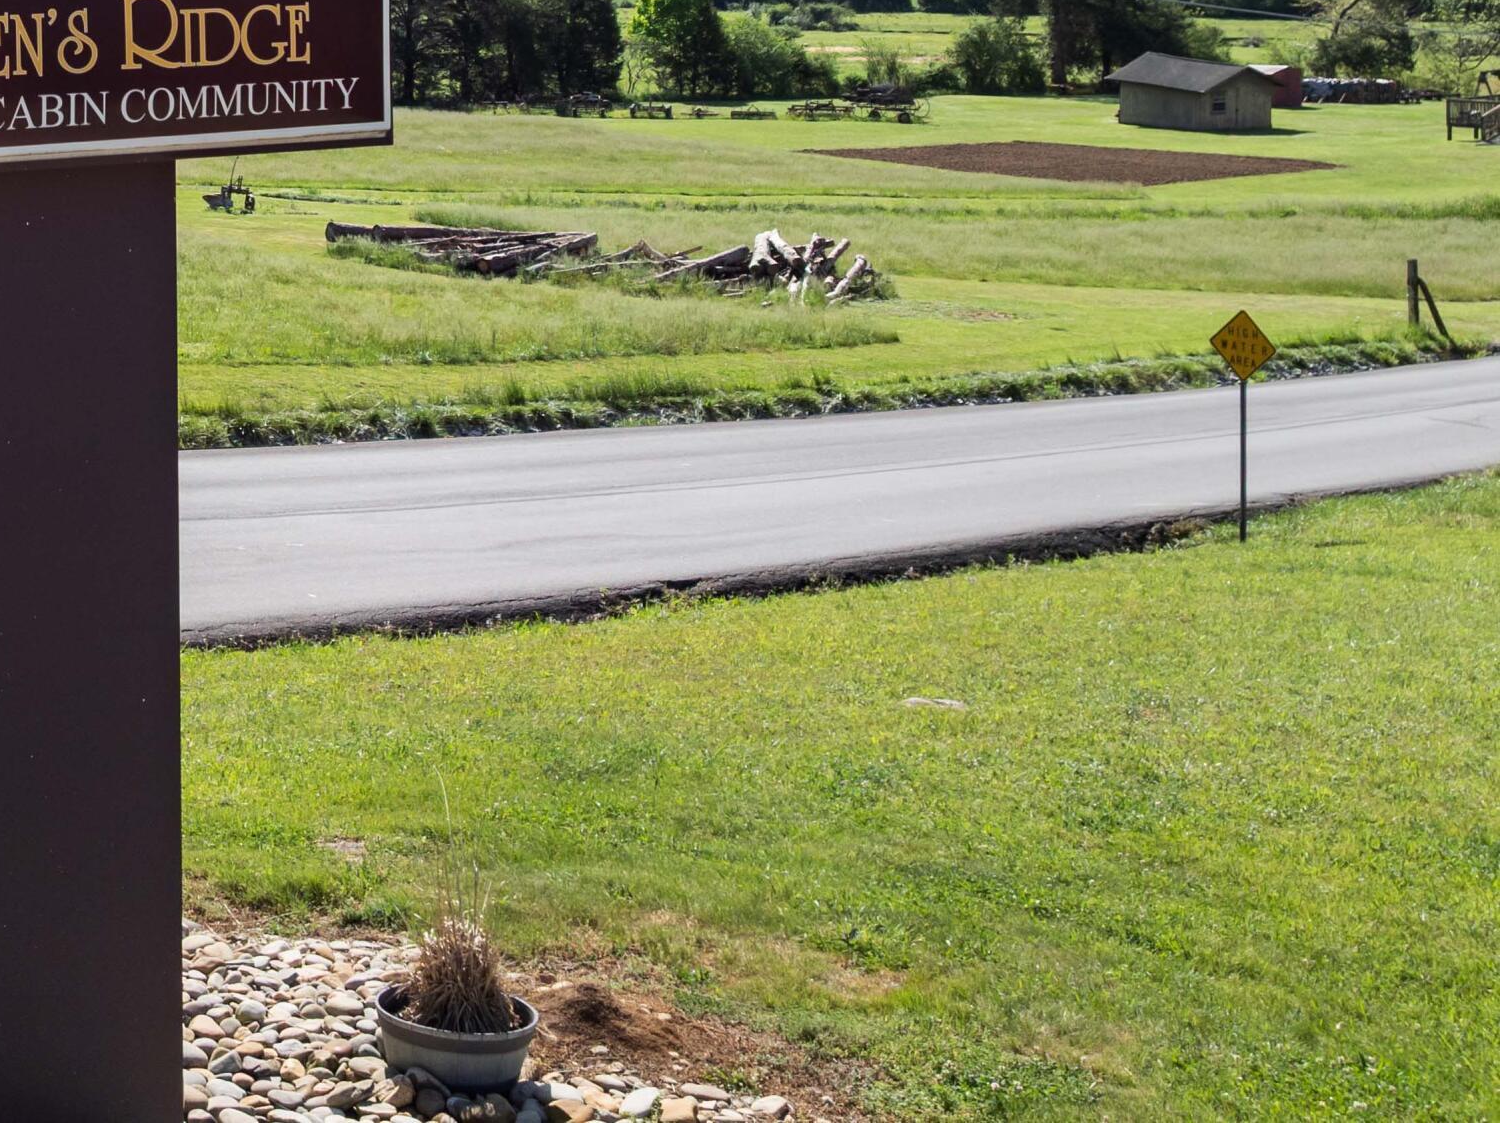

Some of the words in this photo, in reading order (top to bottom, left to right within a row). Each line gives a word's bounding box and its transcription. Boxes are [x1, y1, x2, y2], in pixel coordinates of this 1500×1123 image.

[120, 76, 361, 124] COMMUNITY
[1227, 325, 1259, 340] HIGH
[1221, 339, 1268, 356] WATER
[1229, 355, 1256, 368] AREA
